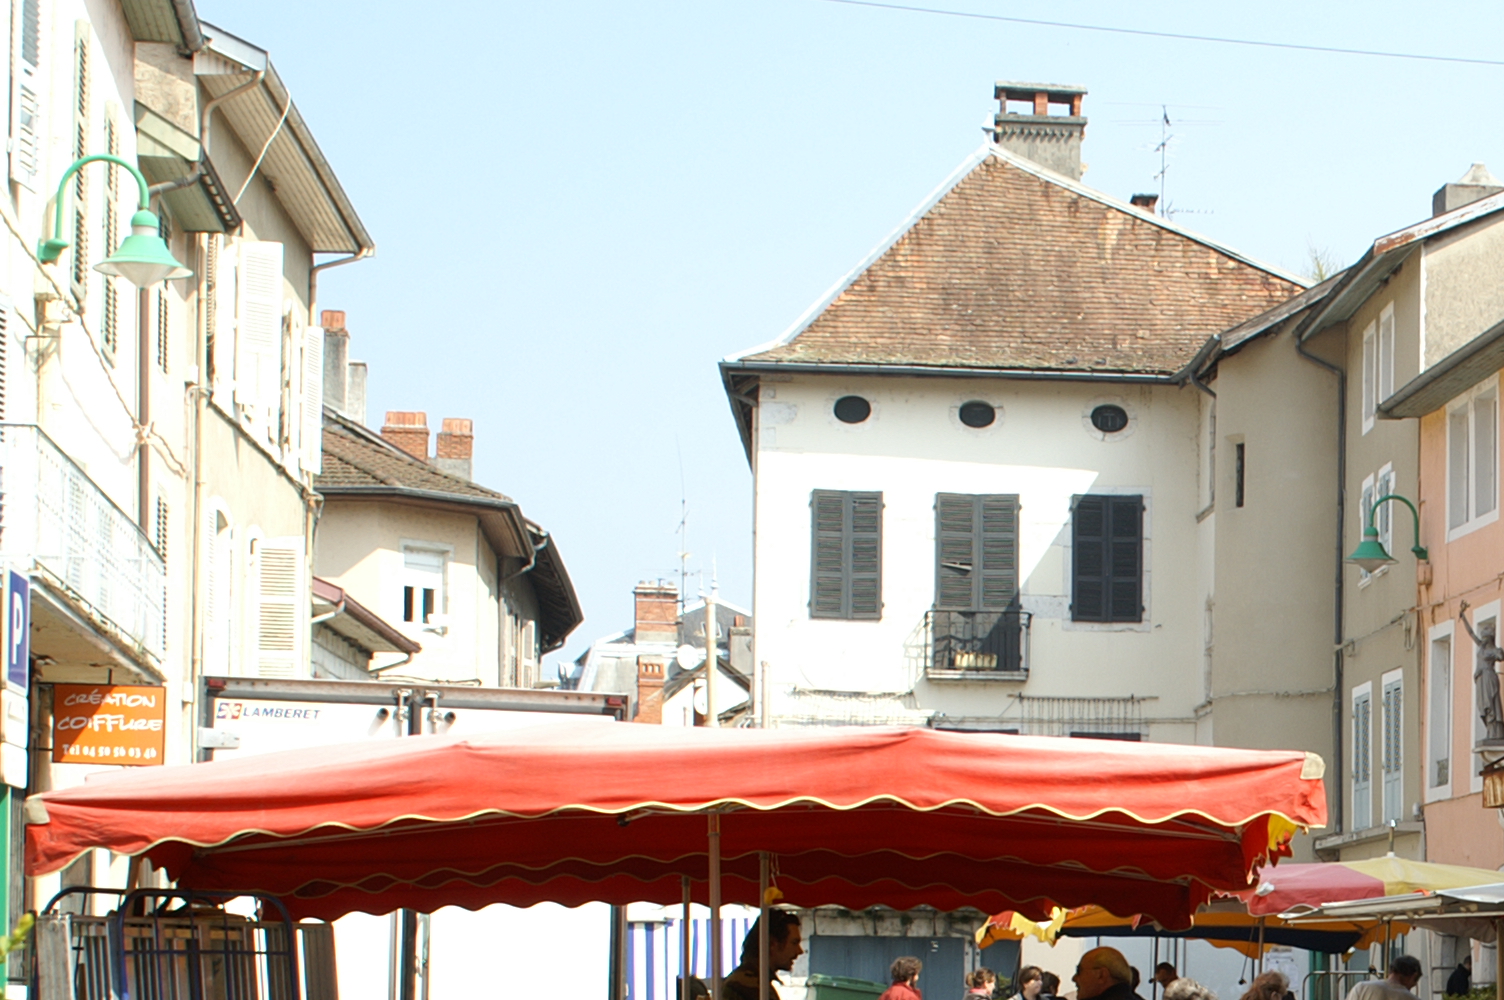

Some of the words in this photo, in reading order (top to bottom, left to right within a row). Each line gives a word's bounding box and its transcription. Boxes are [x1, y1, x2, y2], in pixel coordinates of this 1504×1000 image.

[11, 591, 24, 665] P
[64, 689, 156, 708] CRÉATION
[243, 706, 321, 719] LAMBERET
[57, 713, 163, 732] COIFFURE
[82, 746, 96, 758] 04
[98, 746, 111, 757] 50
[113, 746, 126, 757] 56
[128, 747, 141, 758] 03
